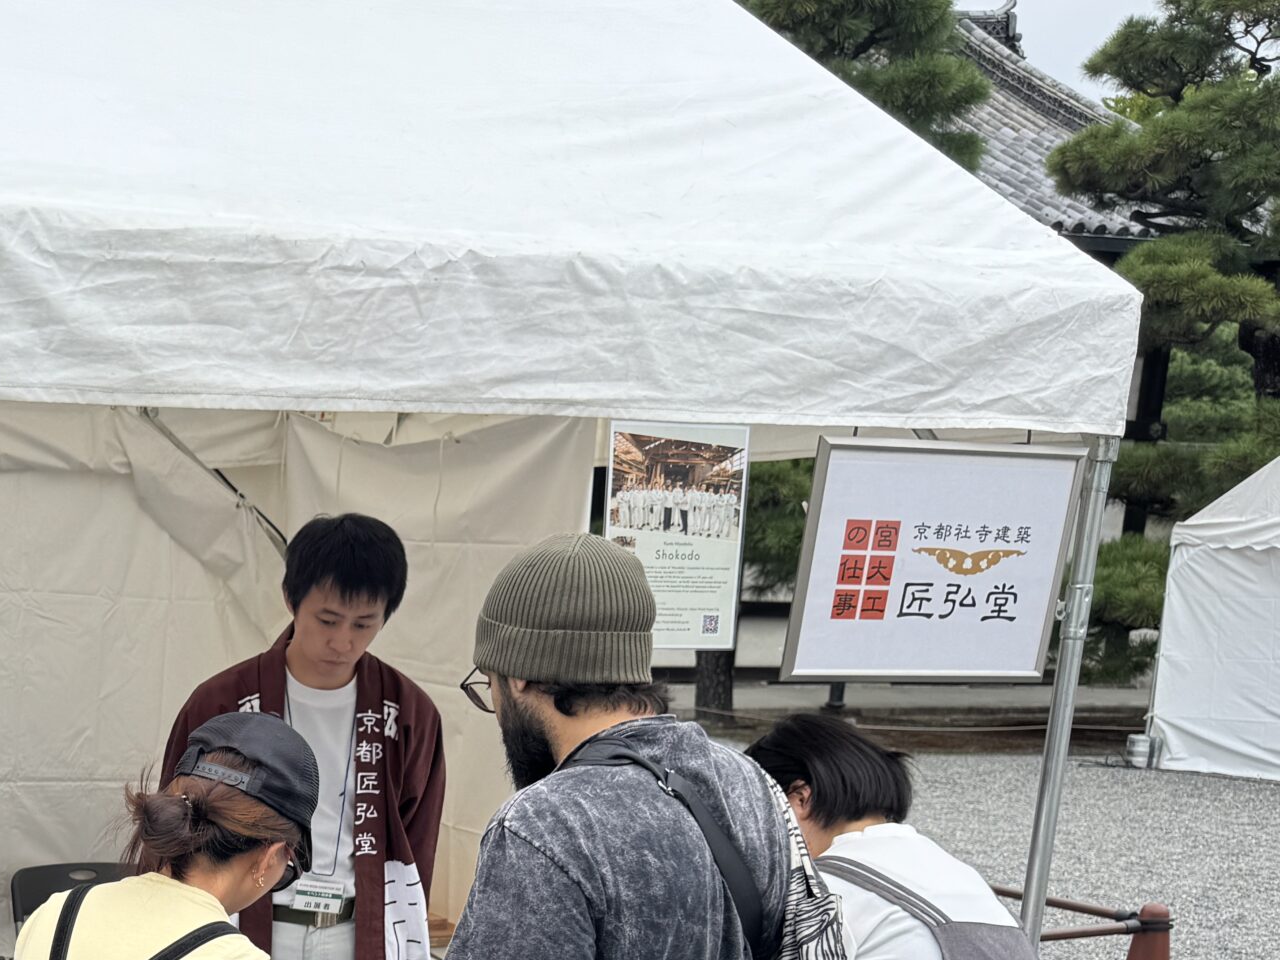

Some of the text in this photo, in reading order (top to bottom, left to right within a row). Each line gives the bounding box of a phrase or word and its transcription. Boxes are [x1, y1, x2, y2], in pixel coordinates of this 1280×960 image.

[654, 549, 701, 561] Shokodo
[913, 521, 1032, 544] 京都社寺建築
[832, 525, 867, 616] の仕事
[860, 523, 899, 614] 宮大工
[896, 581, 1019, 623] 匠弘堂
[354, 709, 384, 858] 京都匠弘堂
